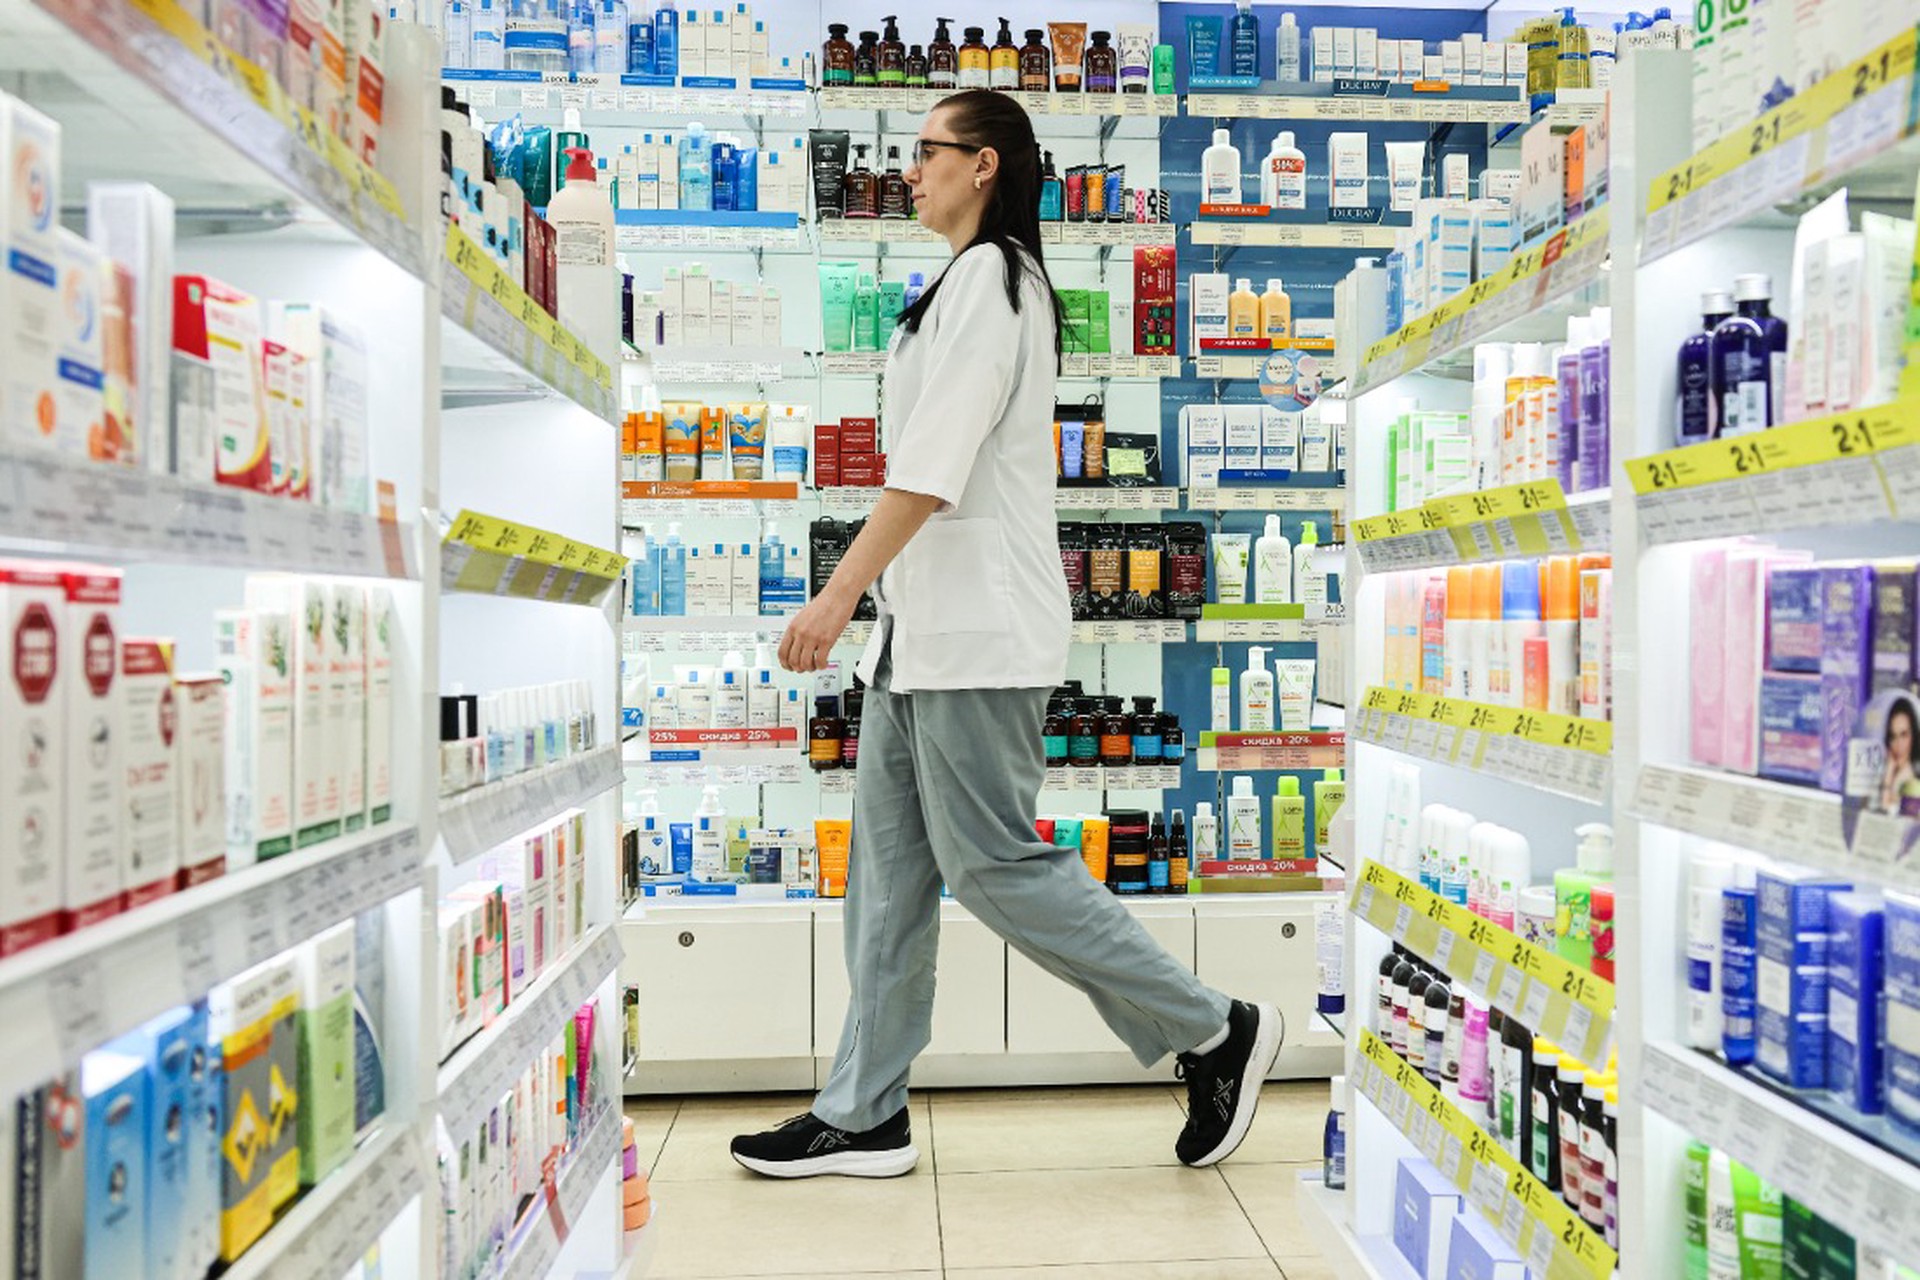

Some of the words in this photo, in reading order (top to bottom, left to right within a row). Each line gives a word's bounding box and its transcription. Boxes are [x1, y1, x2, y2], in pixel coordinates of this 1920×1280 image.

[698, 733, 742, 742] скидка
[744, 730, 771, 740] -25%
[1241, 738, 1283, 746] скидка
[1285, 735, 1312, 745] -20%
[1226, 863, 1268, 873] скидка
[1270, 861, 1296, 871] -20%
